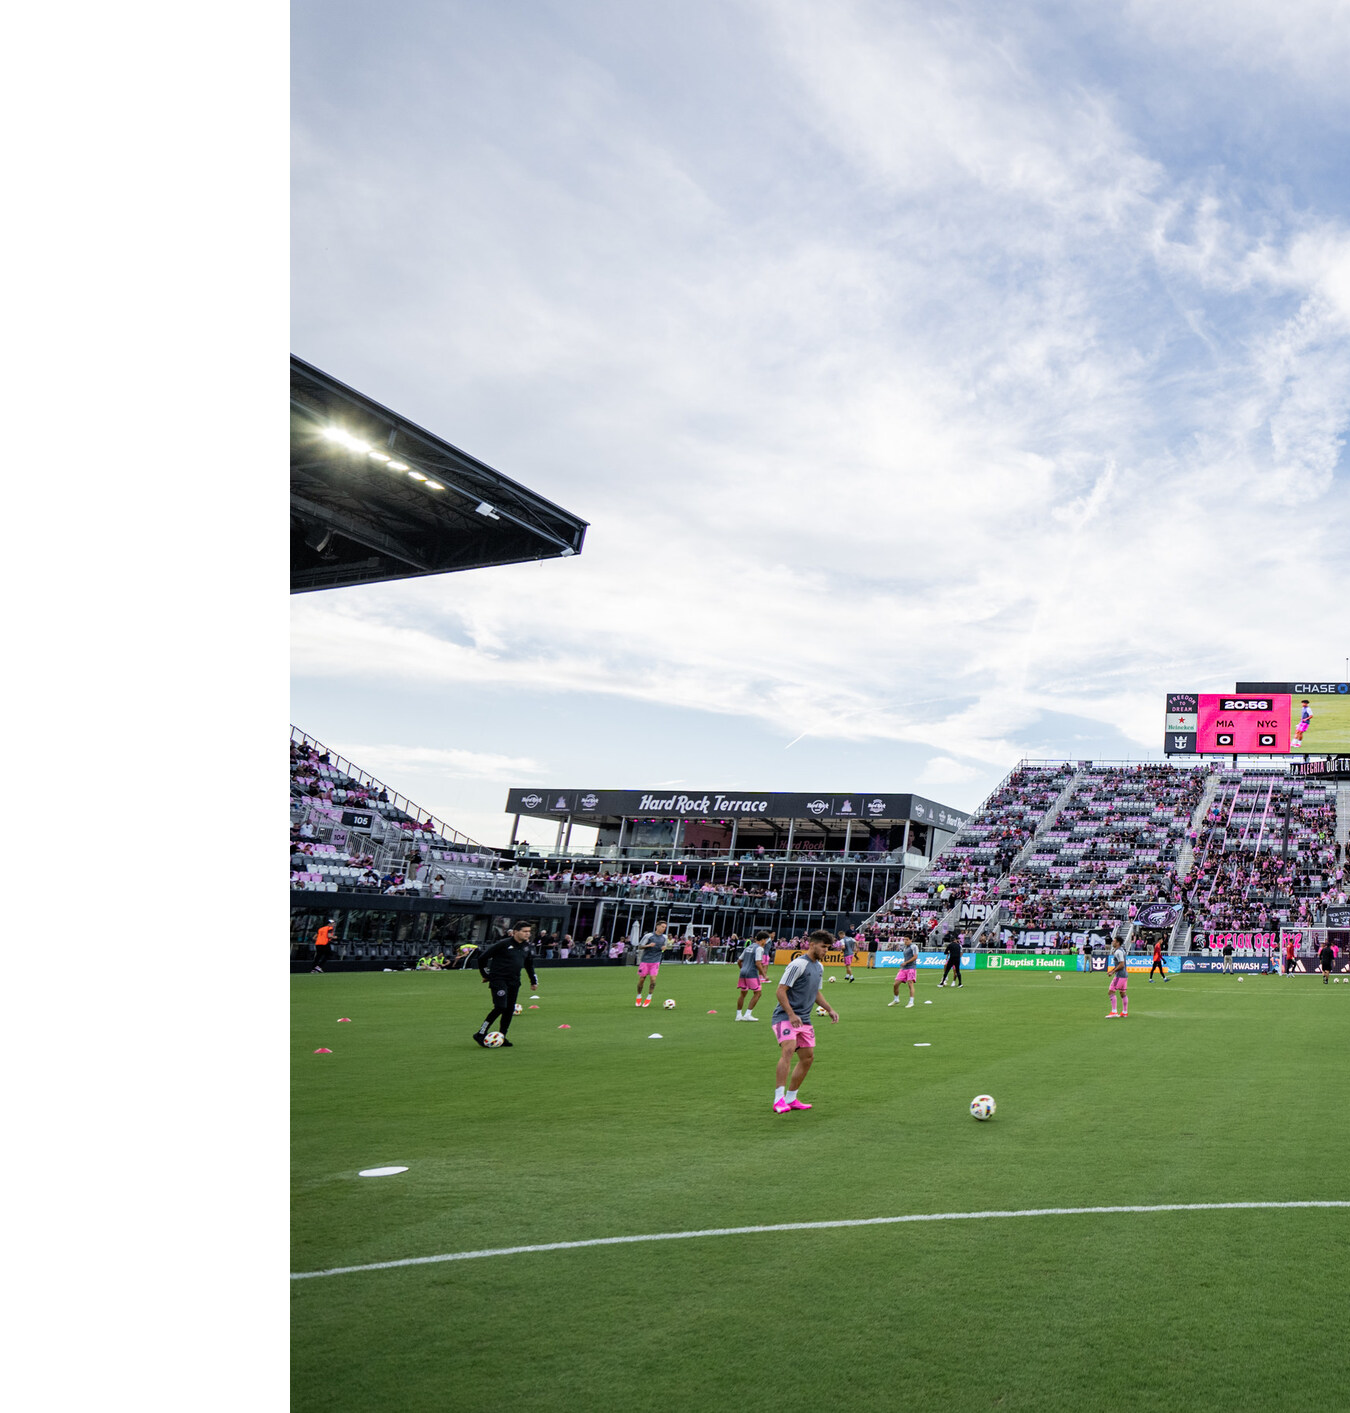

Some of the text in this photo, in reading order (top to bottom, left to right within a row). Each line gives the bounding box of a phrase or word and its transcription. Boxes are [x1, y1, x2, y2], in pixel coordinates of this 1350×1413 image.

[1294, 684, 1336, 693] CHASE
[1169, 694, 1196, 705] FREEDOM
[1224, 701, 1268, 710] 20:56
[1216, 720, 1235, 728] MIA
[1257, 720, 1278, 728] NYC
[1219, 735, 1231, 744] 0
[1261, 735, 1273, 745] 0
[1300, 761, 1325, 775] ALEGRIA
[1326, 760, 1338, 773] QUE
[1340, 759, 1350, 772] LA
[639, 795, 768, 814] Hard Rock Terrace
[353, 816, 368, 825] 105
[780, 840, 801, 850] Hrd
[1254, 932, 1277, 949] DEL
[881, 955, 947, 965] Flora Blue
[1003, 957, 1065, 968] Baptist Health
[1211, 962, 1260, 970] POWRWASH
